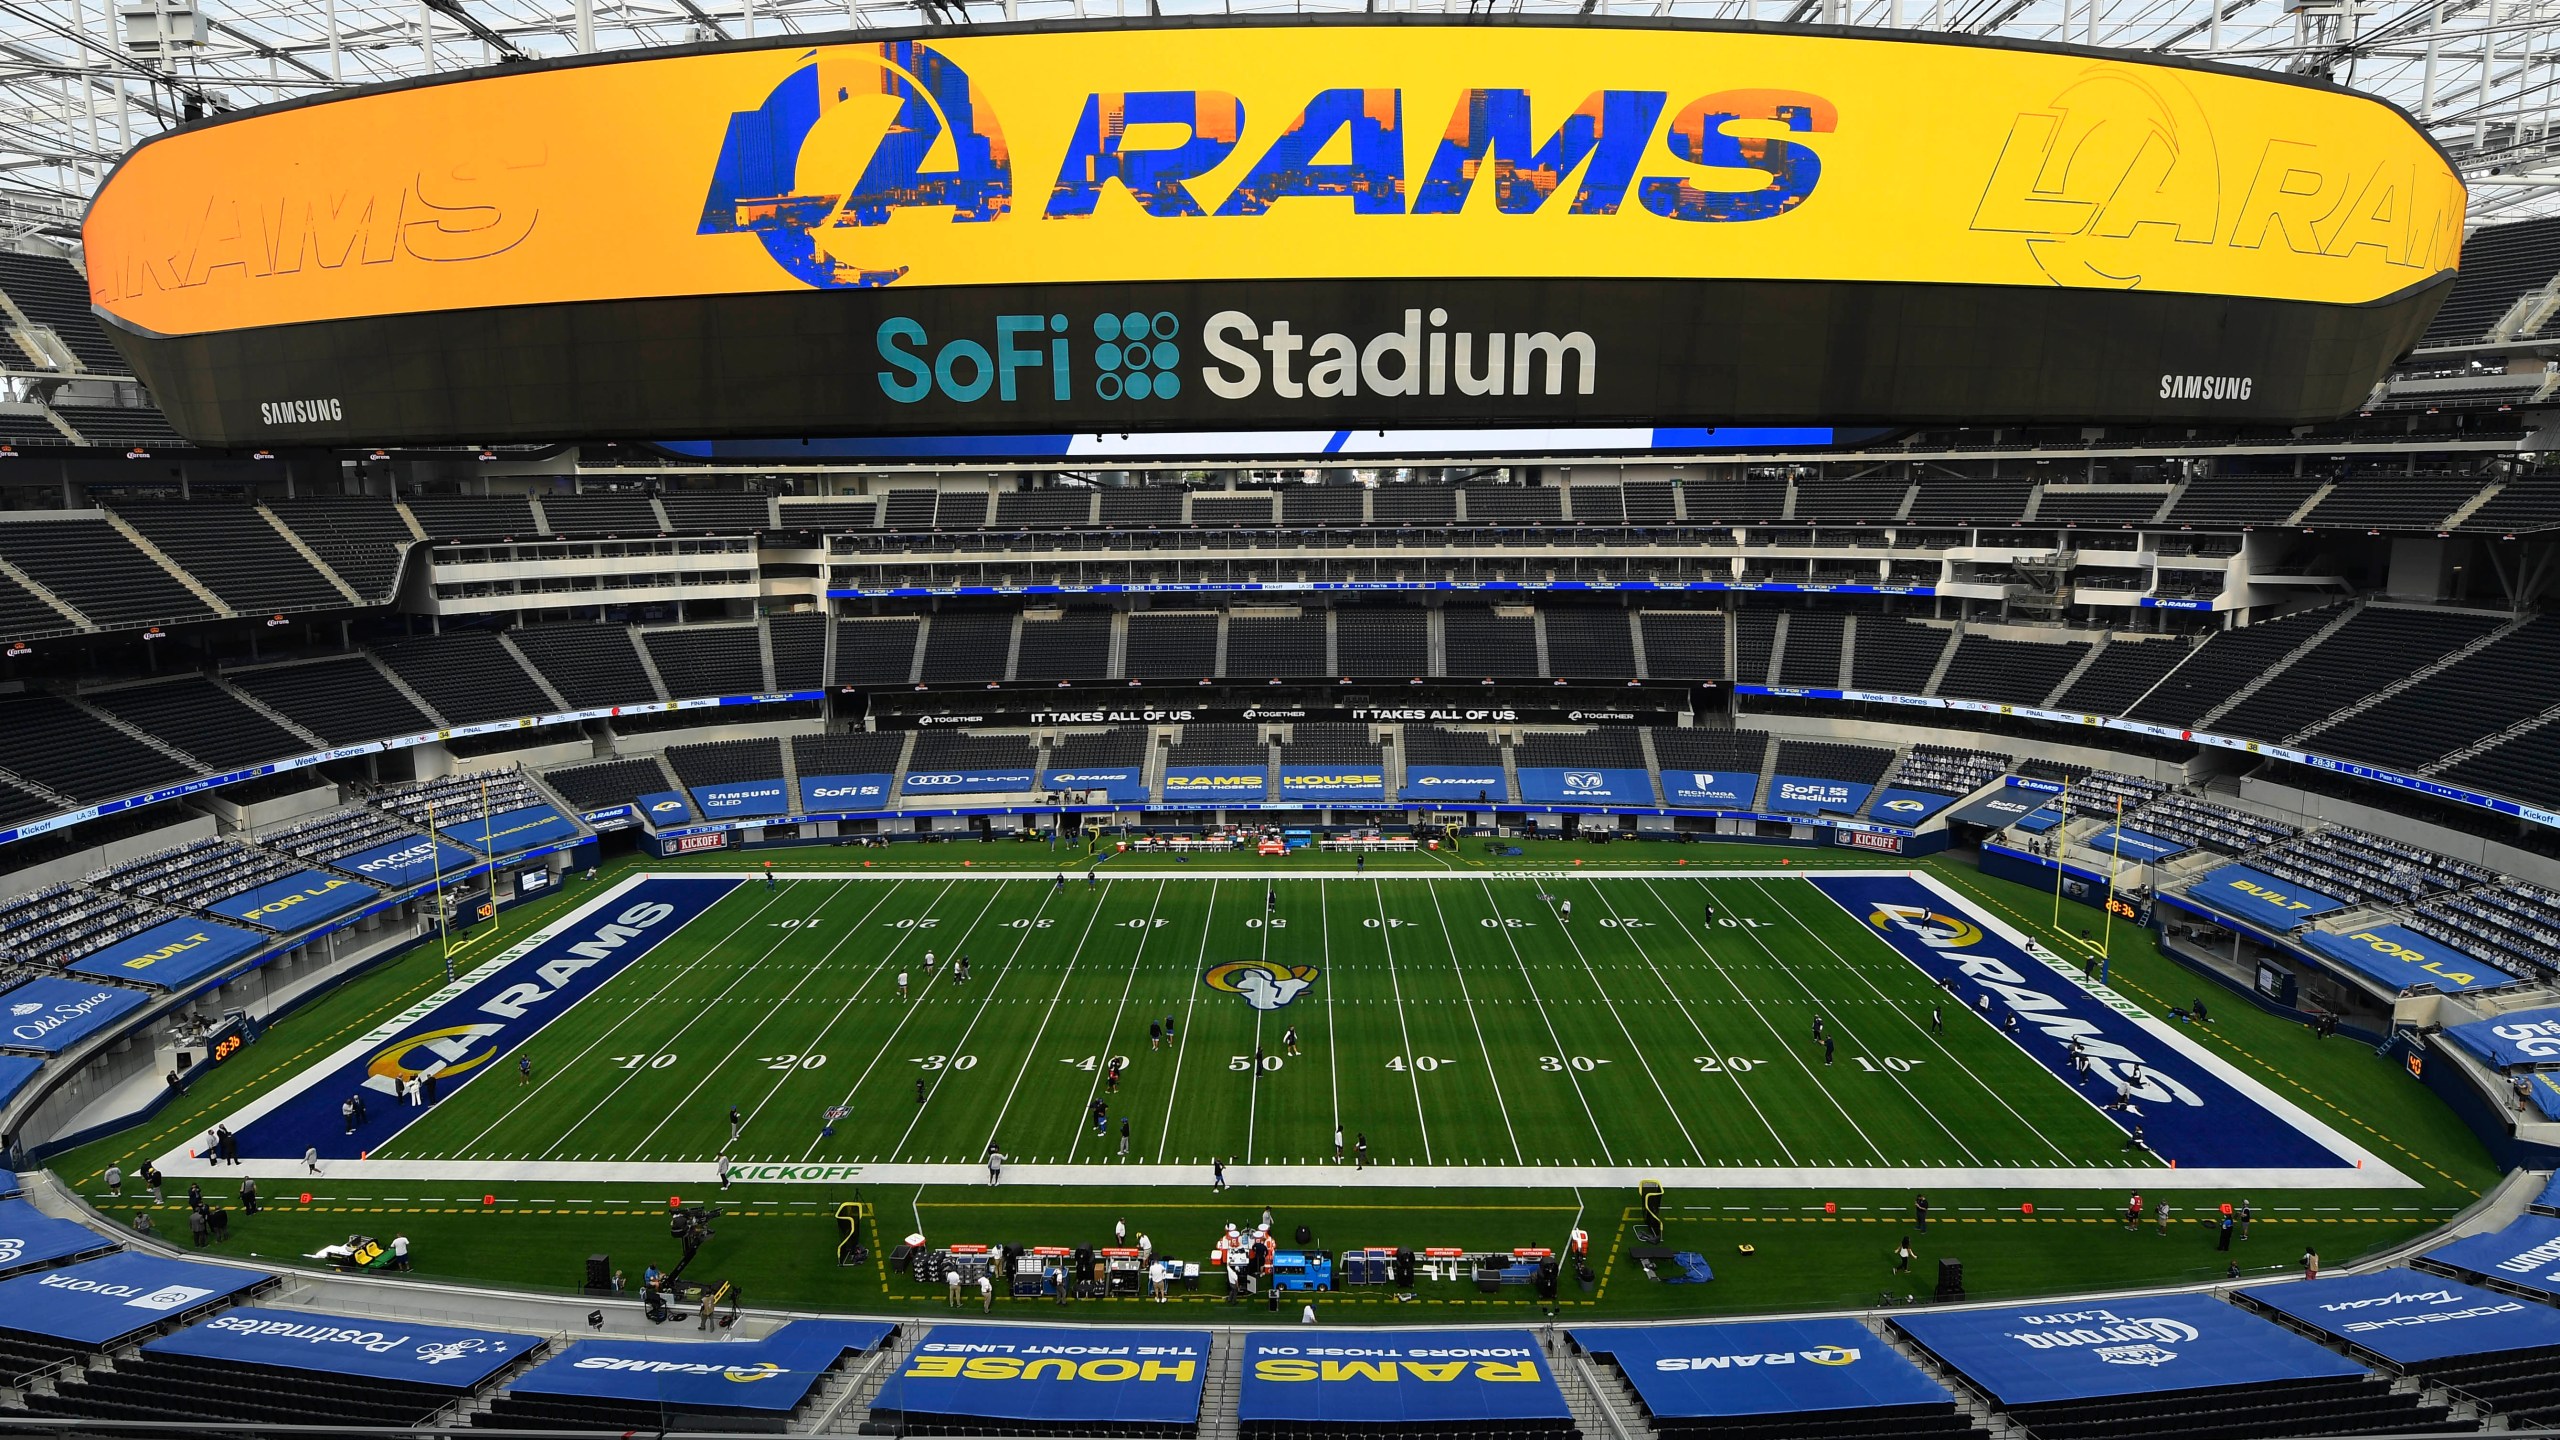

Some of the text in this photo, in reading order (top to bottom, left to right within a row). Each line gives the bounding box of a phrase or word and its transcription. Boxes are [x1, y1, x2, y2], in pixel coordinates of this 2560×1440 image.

[1042, 88, 1838, 222] RAMS
[876, 307, 1596, 403] SoFi Stadium
[2160, 374, 2252, 401] SAMSUNG
[261, 398, 342, 425] SAMSUNG
[7, 647, 32, 657] Corona
[1031, 710, 1195, 723] IT TAKES ALL OF US.
[1353, 710, 1519, 720] IT TAKES ALL OF US.
[1862, 693, 1884, 702] Week
[1900, 696, 1928, 706] Scores
[2026, 710, 2045, 718] FINAL
[2124, 722, 2132, 730] 25
[2148, 726, 2166, 735] FINAL
[2272, 749, 2291, 758] FINAL
[294, 756, 318, 767] Week
[334, 746, 365, 758] Scores
[463, 726, 483, 734] FINAL
[2312, 758, 2336, 769] 28:36
[2352, 767, 2362, 775] Q1
[966, 776, 1030, 784] e-tron
[1166, 776, 1263, 785] RAMS
[1284, 775, 1382, 785] HOUSE
[2030, 782, 2059, 792] RAMS
[708, 789, 780, 800] SAMSUNG
[813, 786, 857, 797] SoFi
[1780, 792, 1848, 804] Stadium
[1781, 784, 1826, 796] SoFi
[708, 799, 742, 807] QLED
[596, 808, 624, 820] RAMS
[2524, 809, 2555, 824] Kickoff
[21, 810, 97, 836] Kickoff LA 35
[682, 834, 719, 850] KICKOFF
[1855, 834, 1894, 849] KICKOFF
[357, 842, 439, 873] ROCKET
[242, 880, 349, 921] FOR LA
[2228, 880, 2313, 911] BUILT
[478, 904, 493, 917] 40
[123, 933, 214, 969] BUILT
[2350, 932, 2477, 987] FOR LA
[478, 901, 674, 1019] RAMS
[362, 1030, 385, 1043] IT
[390, 988, 463, 1025] TAKES
[460, 964, 498, 987] ALL
[498, 948, 524, 967] OF
[521, 934, 551, 948] US
[2034, 952, 2151, 1019] END RACISM
[13, 990, 113, 1041] Old Spice
[1936, 951, 2204, 1107] RAMS
[215, 1036, 241, 1061] 28:36
[618, 1053, 678, 1070] 10
[767, 1054, 827, 1070] 20
[921, 1054, 978, 1071] 30
[1076, 1055, 1130, 1071] 40
[1228, 1055, 1284, 1072] 50
[1385, 1056, 1439, 1072] 40
[1539, 1056, 1595, 1072] 30
[1694, 1056, 1753, 1072] 20
[1852, 1056, 1911, 1072] 10
[2409, 1056, 2422, 1075] 40
[726, 1166, 863, 1180] KICKOFF
[39, 1274, 144, 1297] TOYOTA
[2320, 1290, 2463, 1313] Taycan
[2020, 1310, 2125, 1326] Extra
[2342, 1302, 2525, 1333] PORSCHE
[206, 1316, 412, 1353] Postmates
[2014, 1316, 2200, 1350] Corona
[924, 1343, 1198, 1356] THE FRONT LINES
[1258, 1346, 1531, 1357] HONORS THOSE ON
[574, 1357, 725, 1374] RAMS
[904, 1356, 1196, 1383] HOUSE
[1656, 1350, 1796, 1372] RAMS
[1254, 1359, 1541, 1383] RAMS
